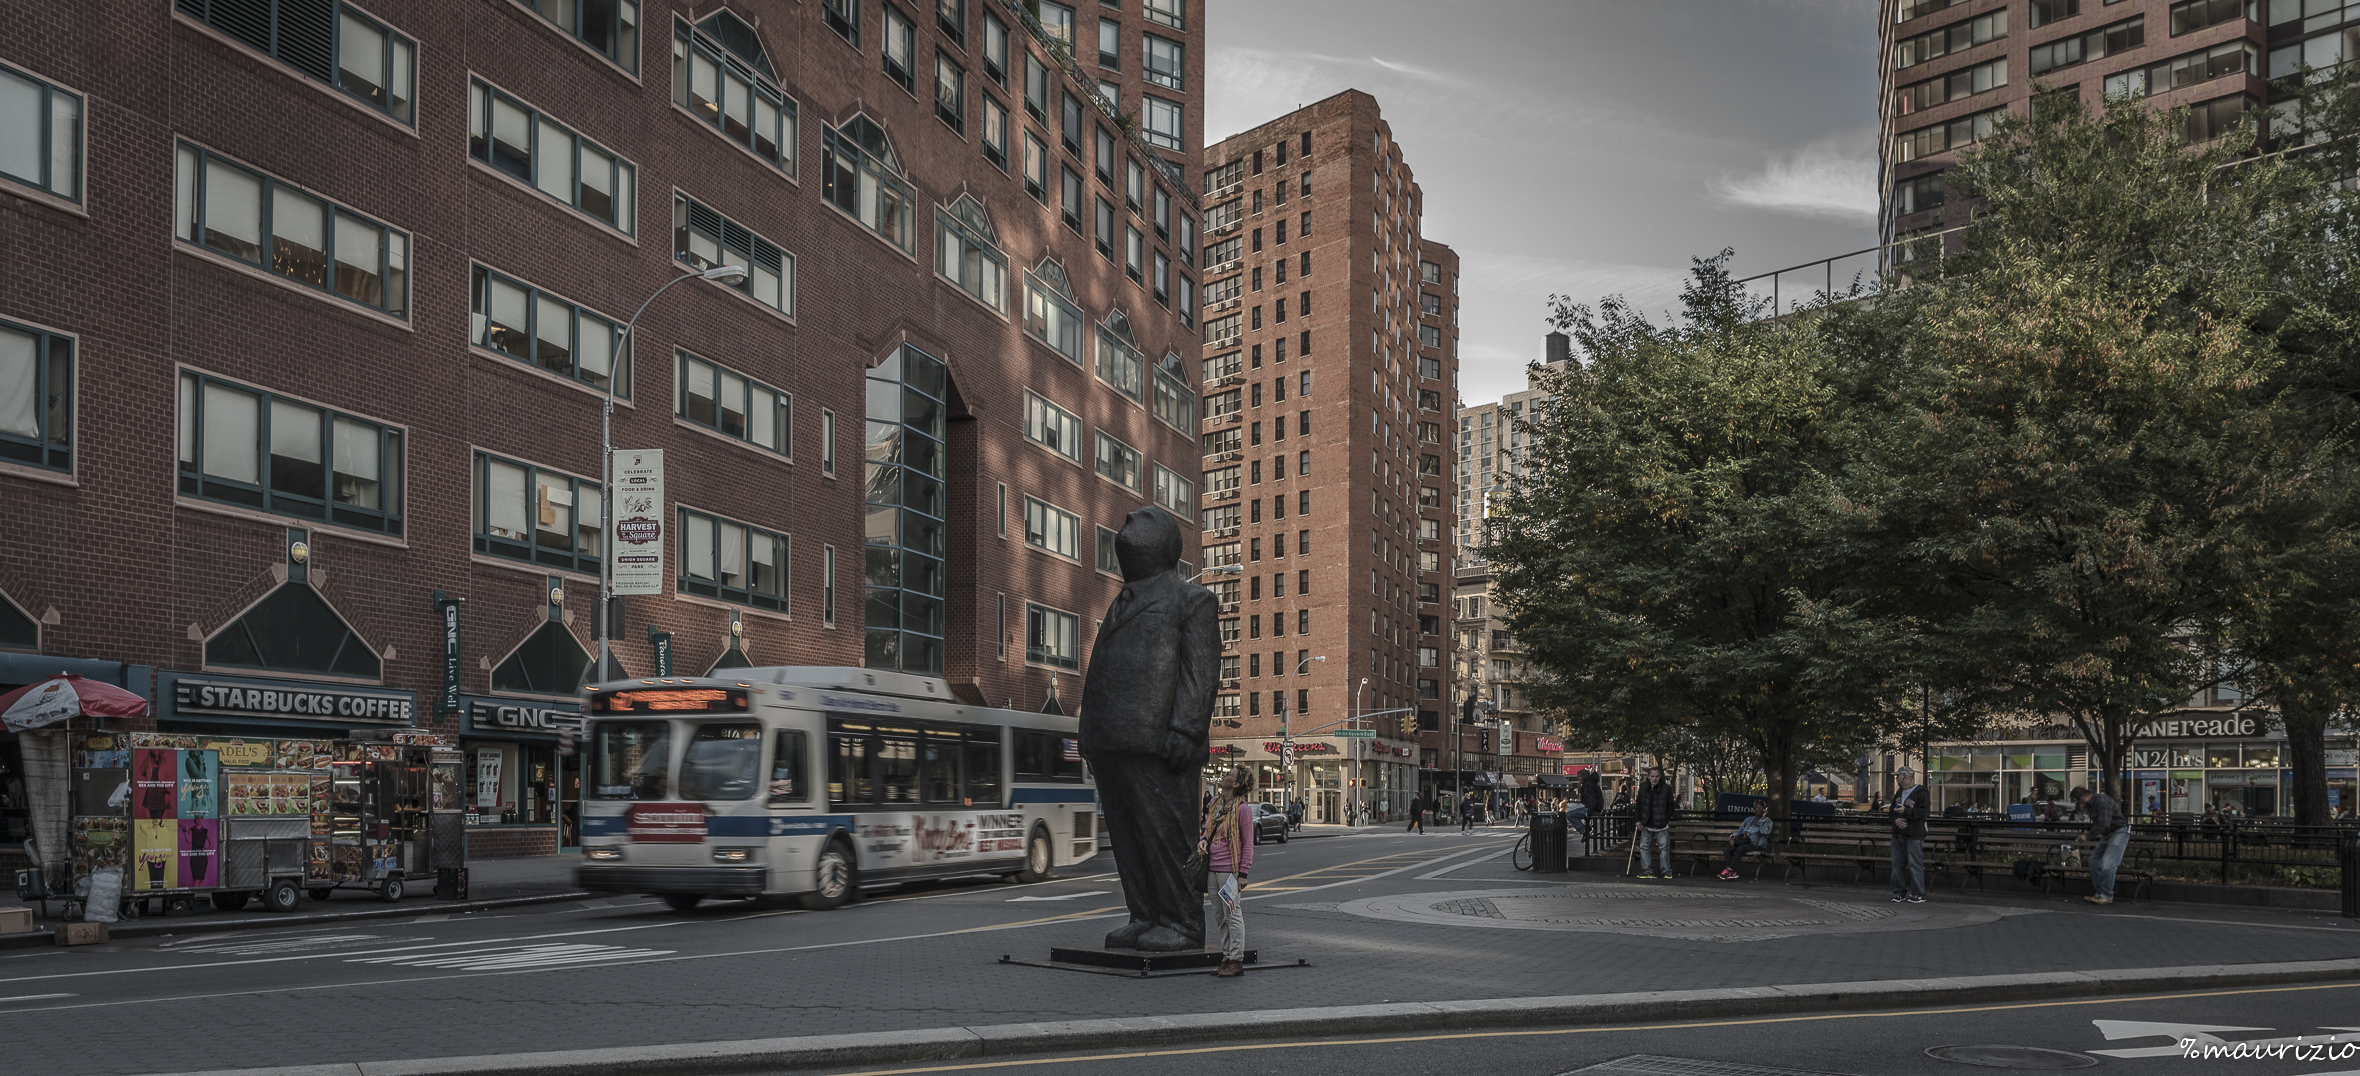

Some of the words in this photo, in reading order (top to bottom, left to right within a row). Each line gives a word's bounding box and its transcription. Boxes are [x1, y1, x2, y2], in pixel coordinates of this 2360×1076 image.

[629, 531, 656, 541] Square
[446, 605, 456, 654] GNC
[659, 639, 667, 676] Panera
[200, 686, 334, 715] STARBUCKS
[338, 697, 410, 719] COFFEE
[448, 685, 457, 707] Well
[497, 706, 556, 728] GNC
[2029, 718, 2082, 740] rack
[219, 747, 258, 756] ADEL'S
[1263, 742, 1325, 752] Wareens
[1727, 805, 1755, 813] UNION
